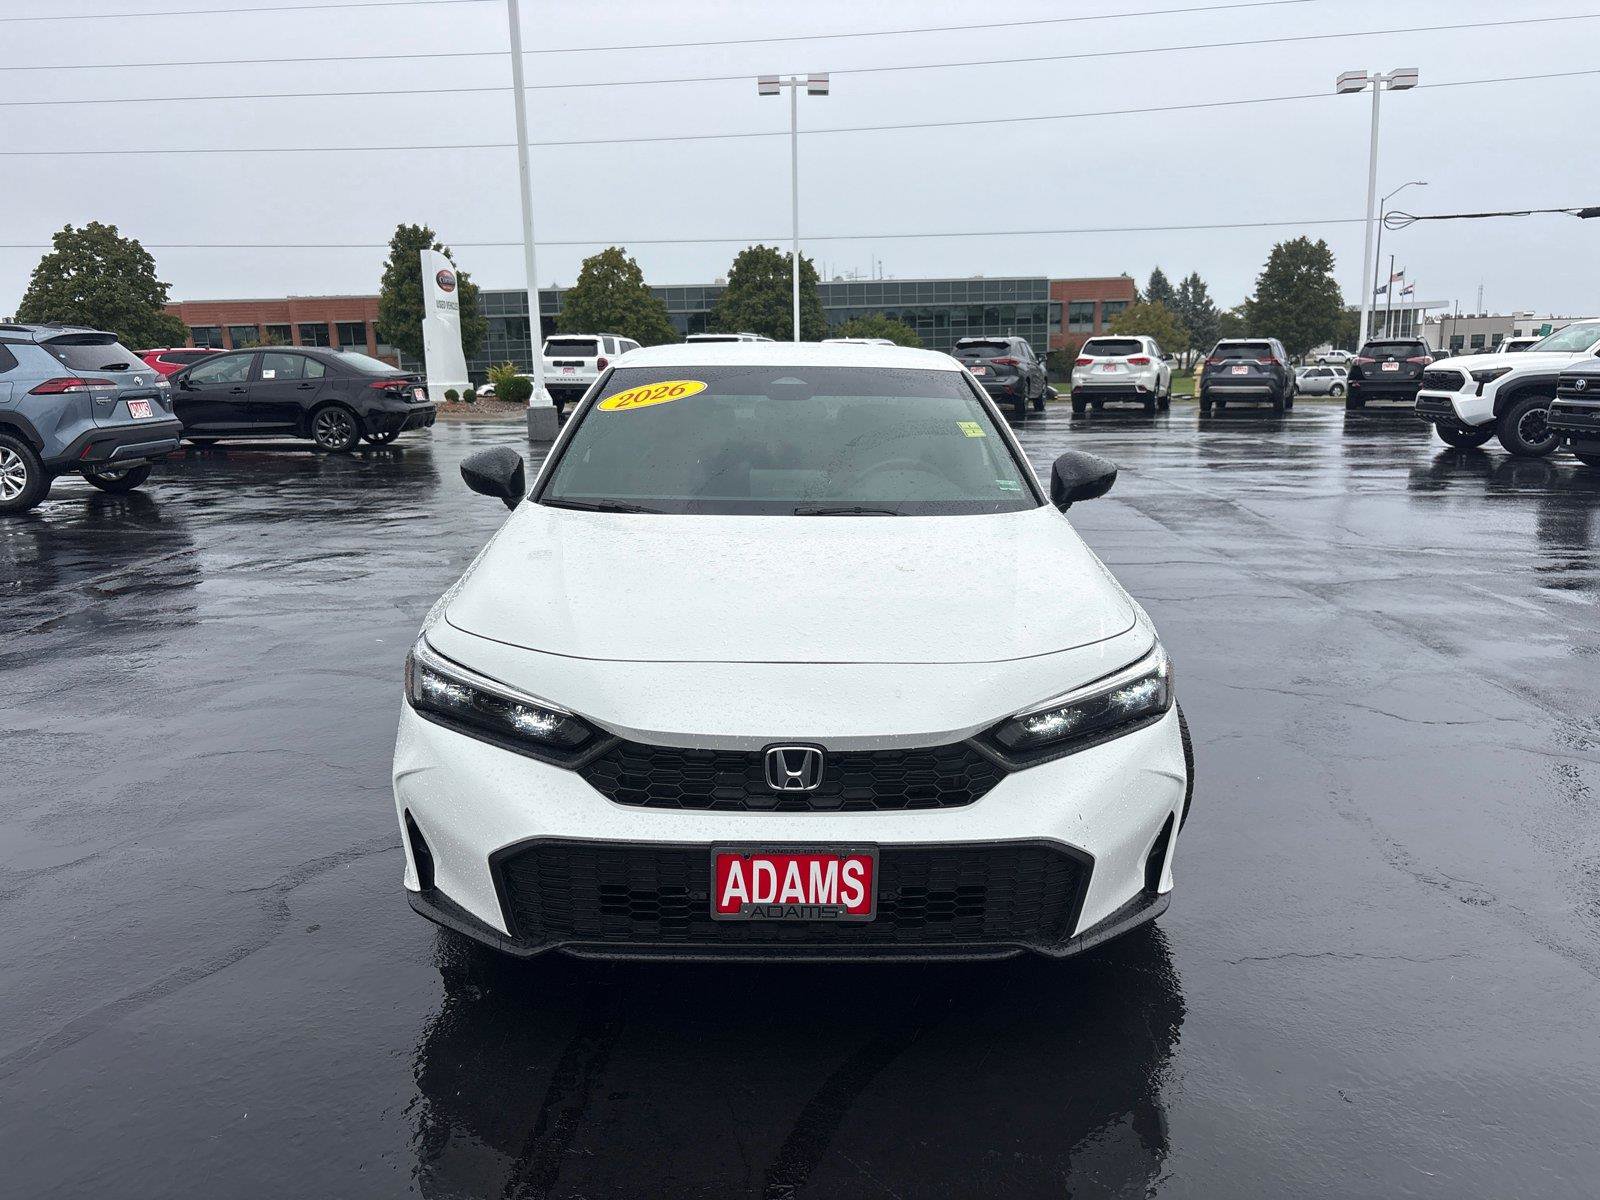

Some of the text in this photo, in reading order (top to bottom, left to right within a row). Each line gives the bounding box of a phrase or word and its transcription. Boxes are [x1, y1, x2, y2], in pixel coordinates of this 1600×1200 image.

[615, 383, 689, 408] 2026
[722, 860, 865, 908] ADAMS
[751, 906, 838, 918] ADAMS
